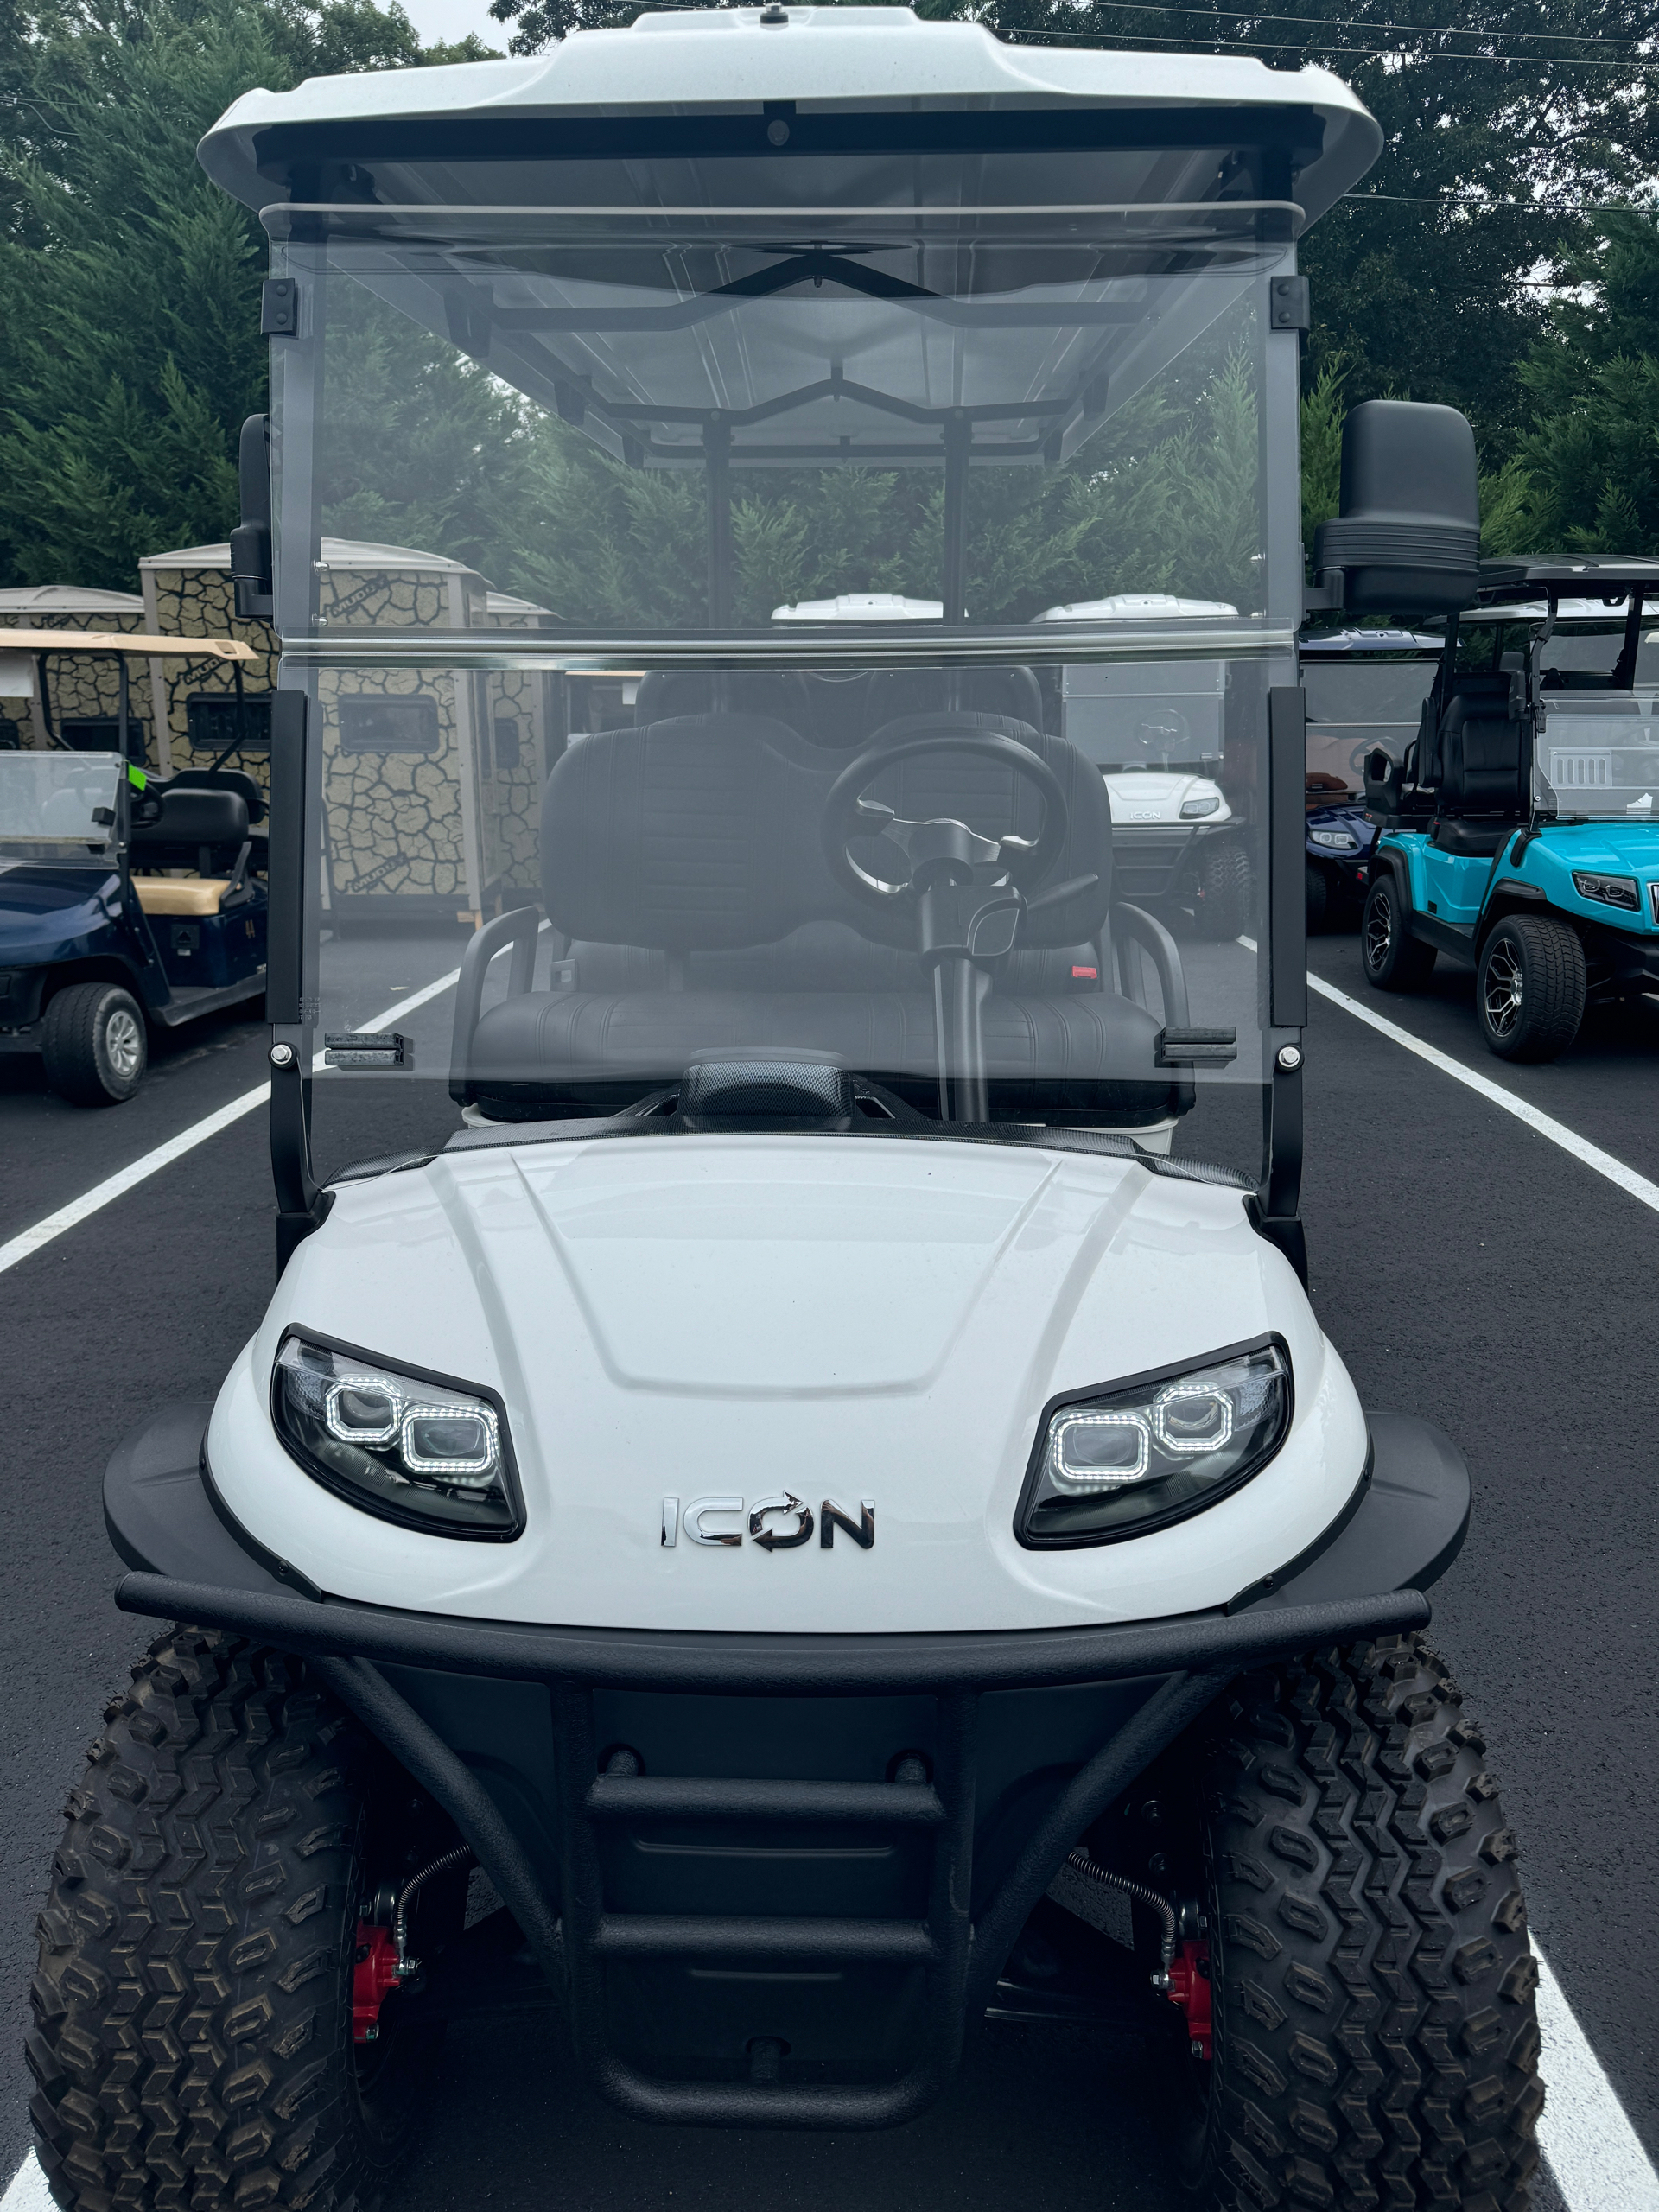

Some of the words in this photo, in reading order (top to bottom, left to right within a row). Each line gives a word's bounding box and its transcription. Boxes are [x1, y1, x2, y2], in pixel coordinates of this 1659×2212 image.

[185, 657, 227, 683] MUD
[1130, 811, 1161, 820] ICON
[660, 1489, 875, 1553] ICON
